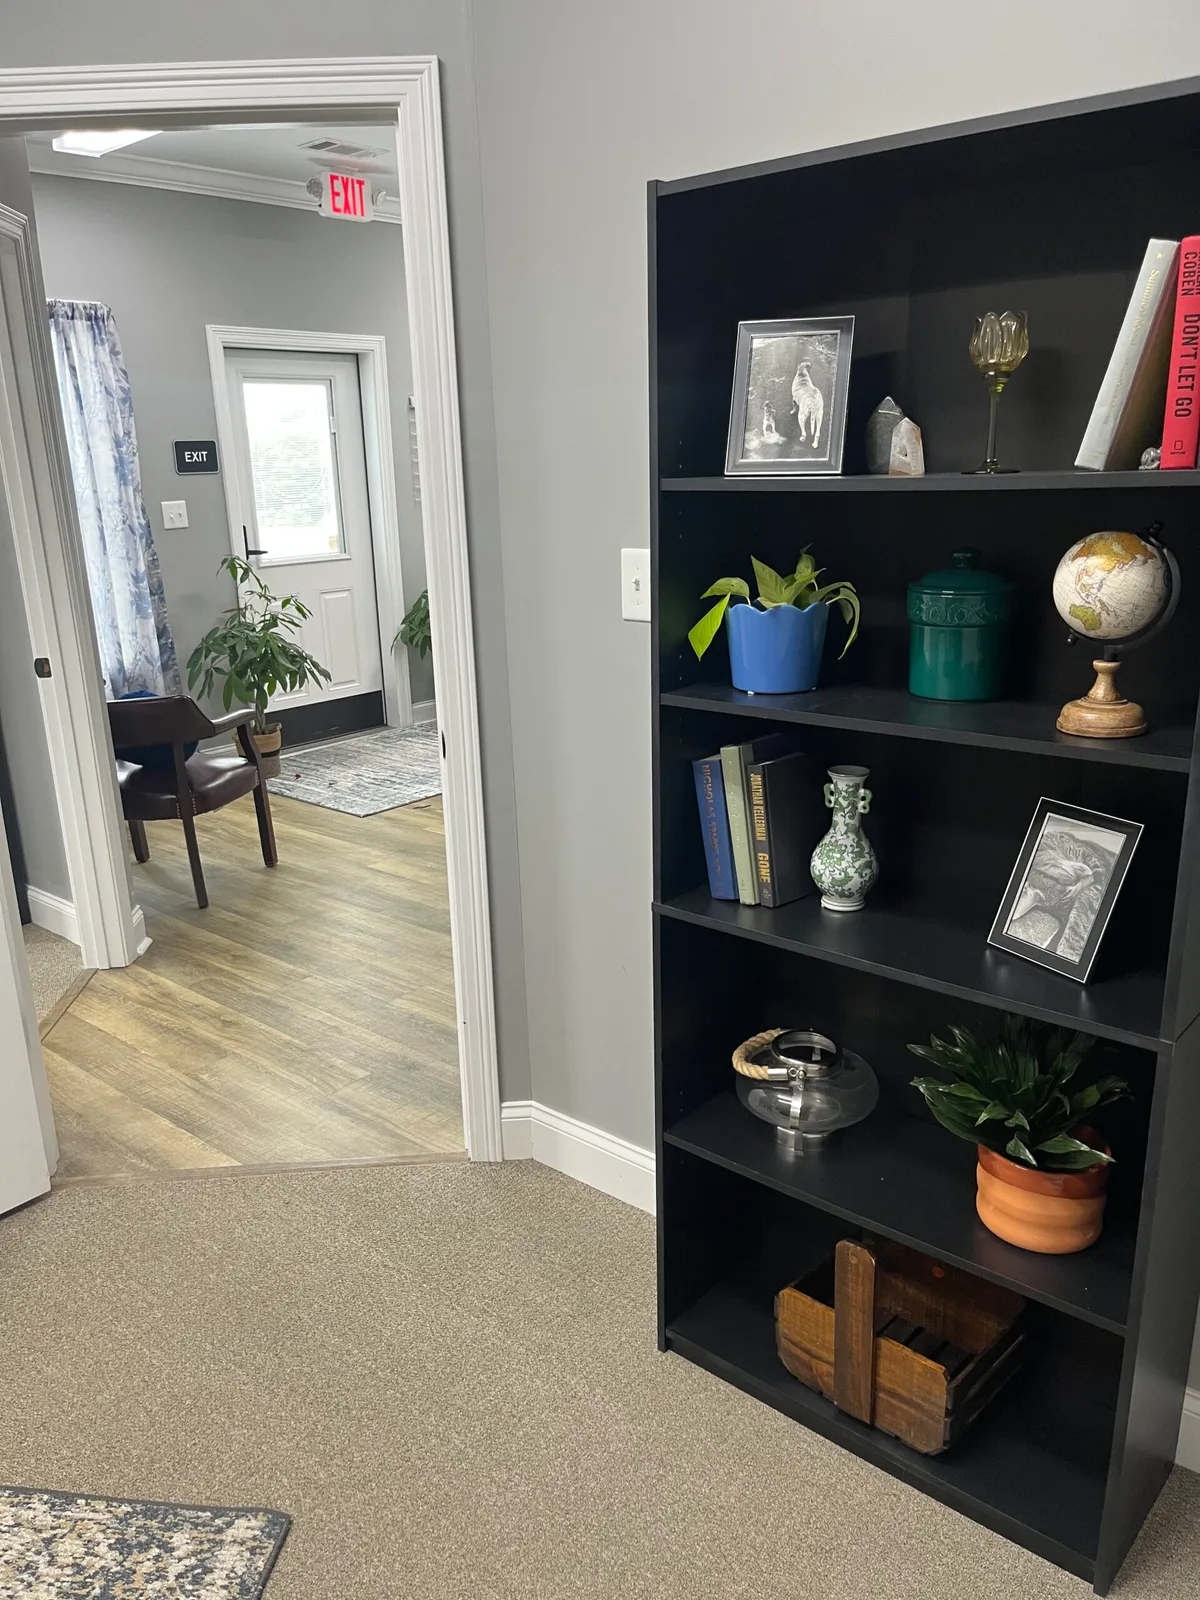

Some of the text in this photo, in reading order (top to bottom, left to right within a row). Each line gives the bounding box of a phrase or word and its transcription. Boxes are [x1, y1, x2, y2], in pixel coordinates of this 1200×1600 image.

[329, 174, 365, 217] EXIT
[1181, 251, 1198, 296] COBEN
[1174, 314, 1200, 417] DON'T LET GO
[184, 451, 208, 462] EXIT
[750, 773, 767, 841] JONATHAN KELLERMAN
[757, 852, 771, 883] GONE
